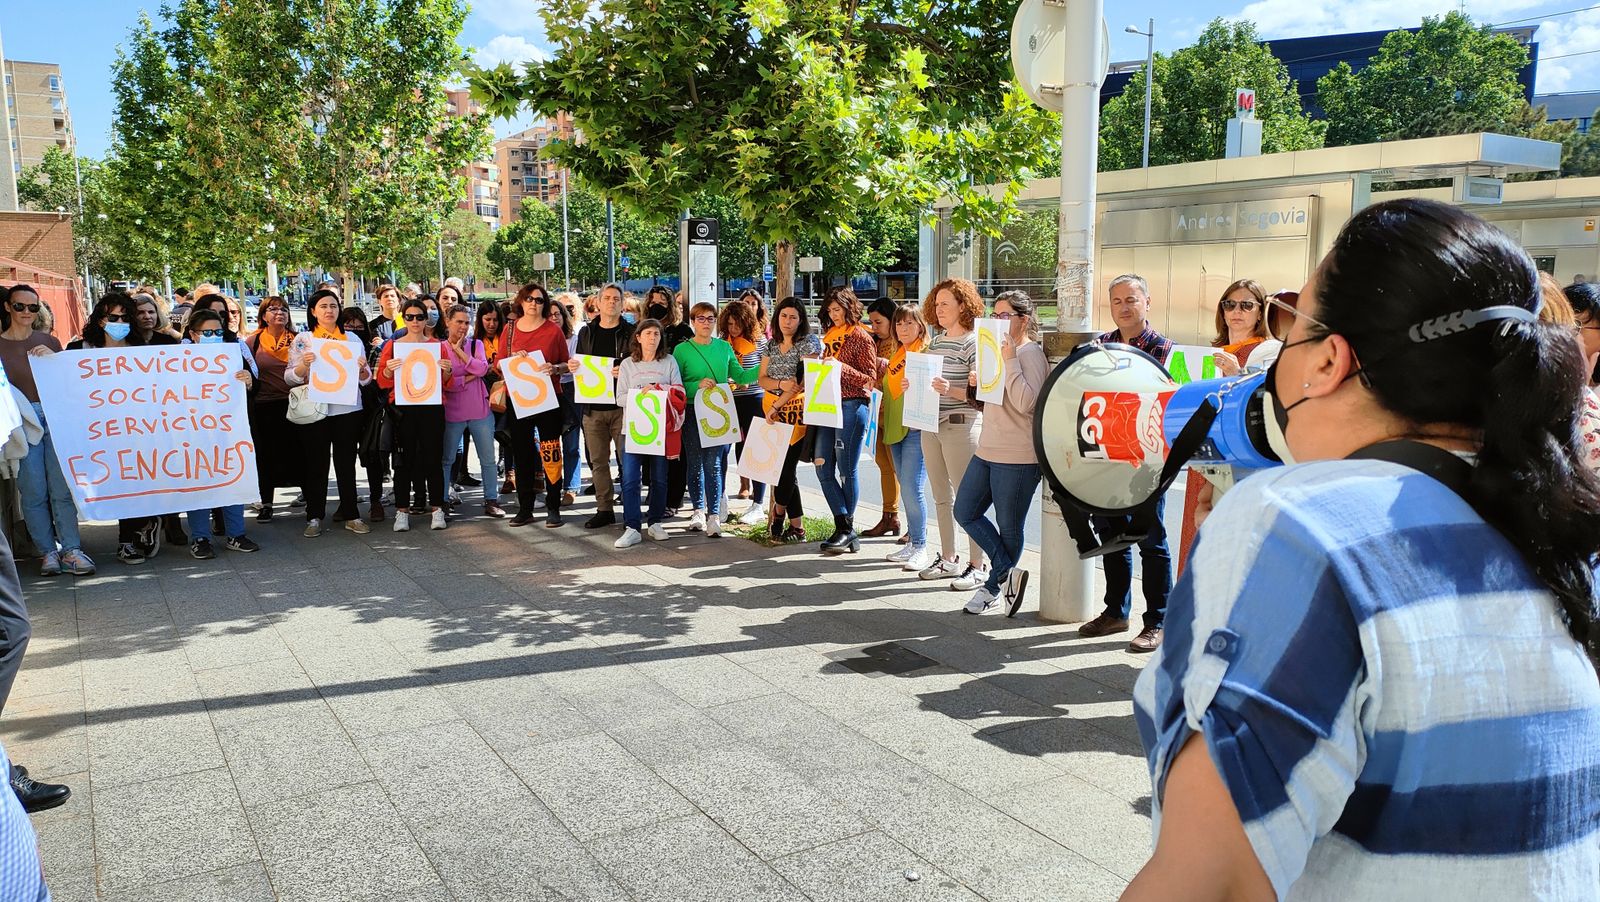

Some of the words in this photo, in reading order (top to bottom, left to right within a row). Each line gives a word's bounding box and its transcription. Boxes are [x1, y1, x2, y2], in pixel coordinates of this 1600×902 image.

[1176, 210, 1231, 231] Andrés
[1239, 206, 1306, 231] Segovia
[312, 341, 353, 393] S
[400, 348, 438, 403] O
[508, 355, 548, 408] S
[978, 326, 1003, 394] D
[806, 362, 838, 415] Z
[1080, 395, 1109, 461] CGT
